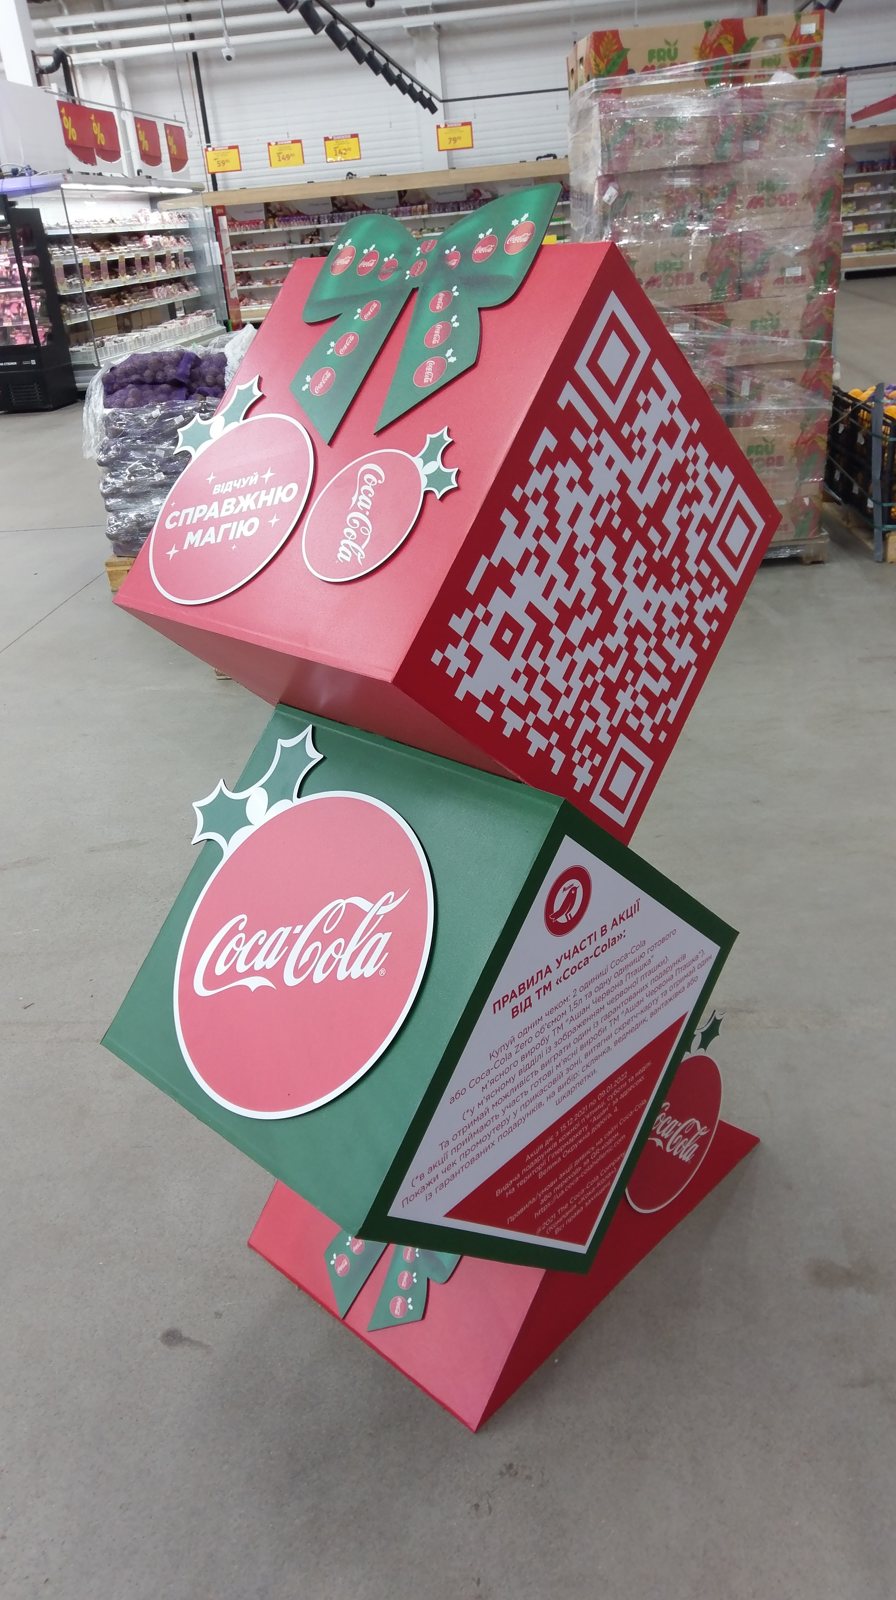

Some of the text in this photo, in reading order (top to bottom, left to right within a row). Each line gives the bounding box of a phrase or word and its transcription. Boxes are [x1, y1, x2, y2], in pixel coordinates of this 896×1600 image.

[164, 482, 298, 530] СПРАВЖНЮ
[183, 517, 260, 550] МАГІЮ
[212, 472, 258, 495] ВІДЧУЙ
[336, 463, 385, 566] Coca-Cola
[193, 888, 410, 997] Coca-Cola
[492, 898, 640, 1014] ПРАВИЛА УЧАСТІ В АКЦІЇ
[511, 929, 625, 1018] ВІД ТМ «Coca-Cola»:
[449, 1087, 466, 1104] або
[468, 1051, 512, 1088] Coca-Cola
[514, 1036, 532, 1054] Zero
[584, 990, 592, 1000] та
[593, 975, 612, 993] одну
[613, 951, 645, 978] одиницю
[646, 928, 676, 954] готового
[489, 939, 645, 1060] Купуй одним чеком: 2 одиниці Coca-Cola
[518, 1051, 543, 1076] відділі
[545, 1045, 551, 1054] із
[554, 1004, 604, 1048] зображенням
[606, 977, 638, 1005] червоної
[520, 1034, 549, 1062] виробу
[551, 1022, 563, 1036] ТМ
[591, 979, 623, 1004] Червона
[401, 1173, 438, 1207] Покажи
[441, 1159, 456, 1174] чек
[459, 1114, 510, 1161] промоутеру
[519, 1070, 563, 1111] прикасовій
[565, 1056, 582, 1074] зоні,
[584, 1032, 612, 1059] витягни
[614, 996, 658, 1035] скретч-карту
[427, 1150, 448, 1174] акції
[450, 1114, 499, 1155] приймають
[501, 1090, 528, 1116] участь
[530, 1065, 553, 1090] готові
[579, 1025, 606, 1050] вироби
[608, 1014, 619, 1026] ТМ
[645, 974, 673, 997] Червона
[438, 1139, 449, 1150] Та
[451, 1106, 489, 1141] отримай
[491, 1069, 538, 1109] можливість
[540, 1042, 571, 1070] виграти
[572, 1026, 591, 1044] один
[600, 984, 648, 1023] гарантованих
[425, 1191, 432, 1201] із
[434, 1140, 494, 1193] гарантованих
[497, 1101, 544, 1142] подарунків,
[546, 1090, 555, 1101] на
